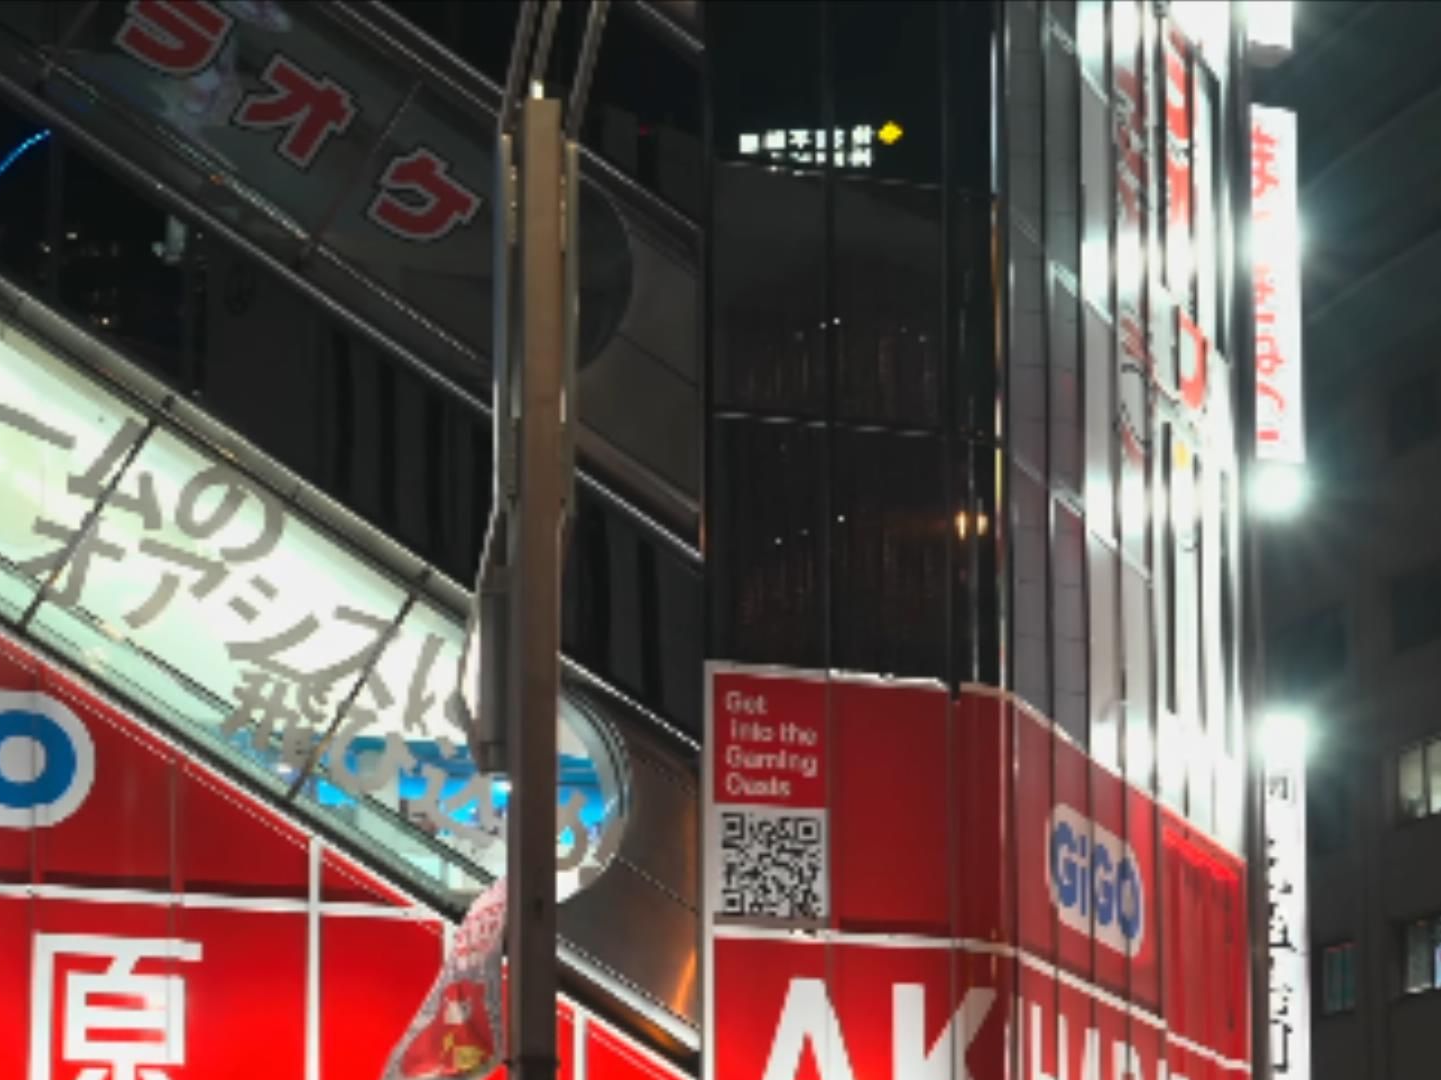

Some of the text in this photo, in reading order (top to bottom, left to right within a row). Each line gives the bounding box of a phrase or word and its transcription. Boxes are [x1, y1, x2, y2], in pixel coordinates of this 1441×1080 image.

[725, 691, 767, 714] Get
[779, 722, 817, 747] the
[725, 746, 818, 778] Gaming
[1050, 821, 1141, 939] GiGO
